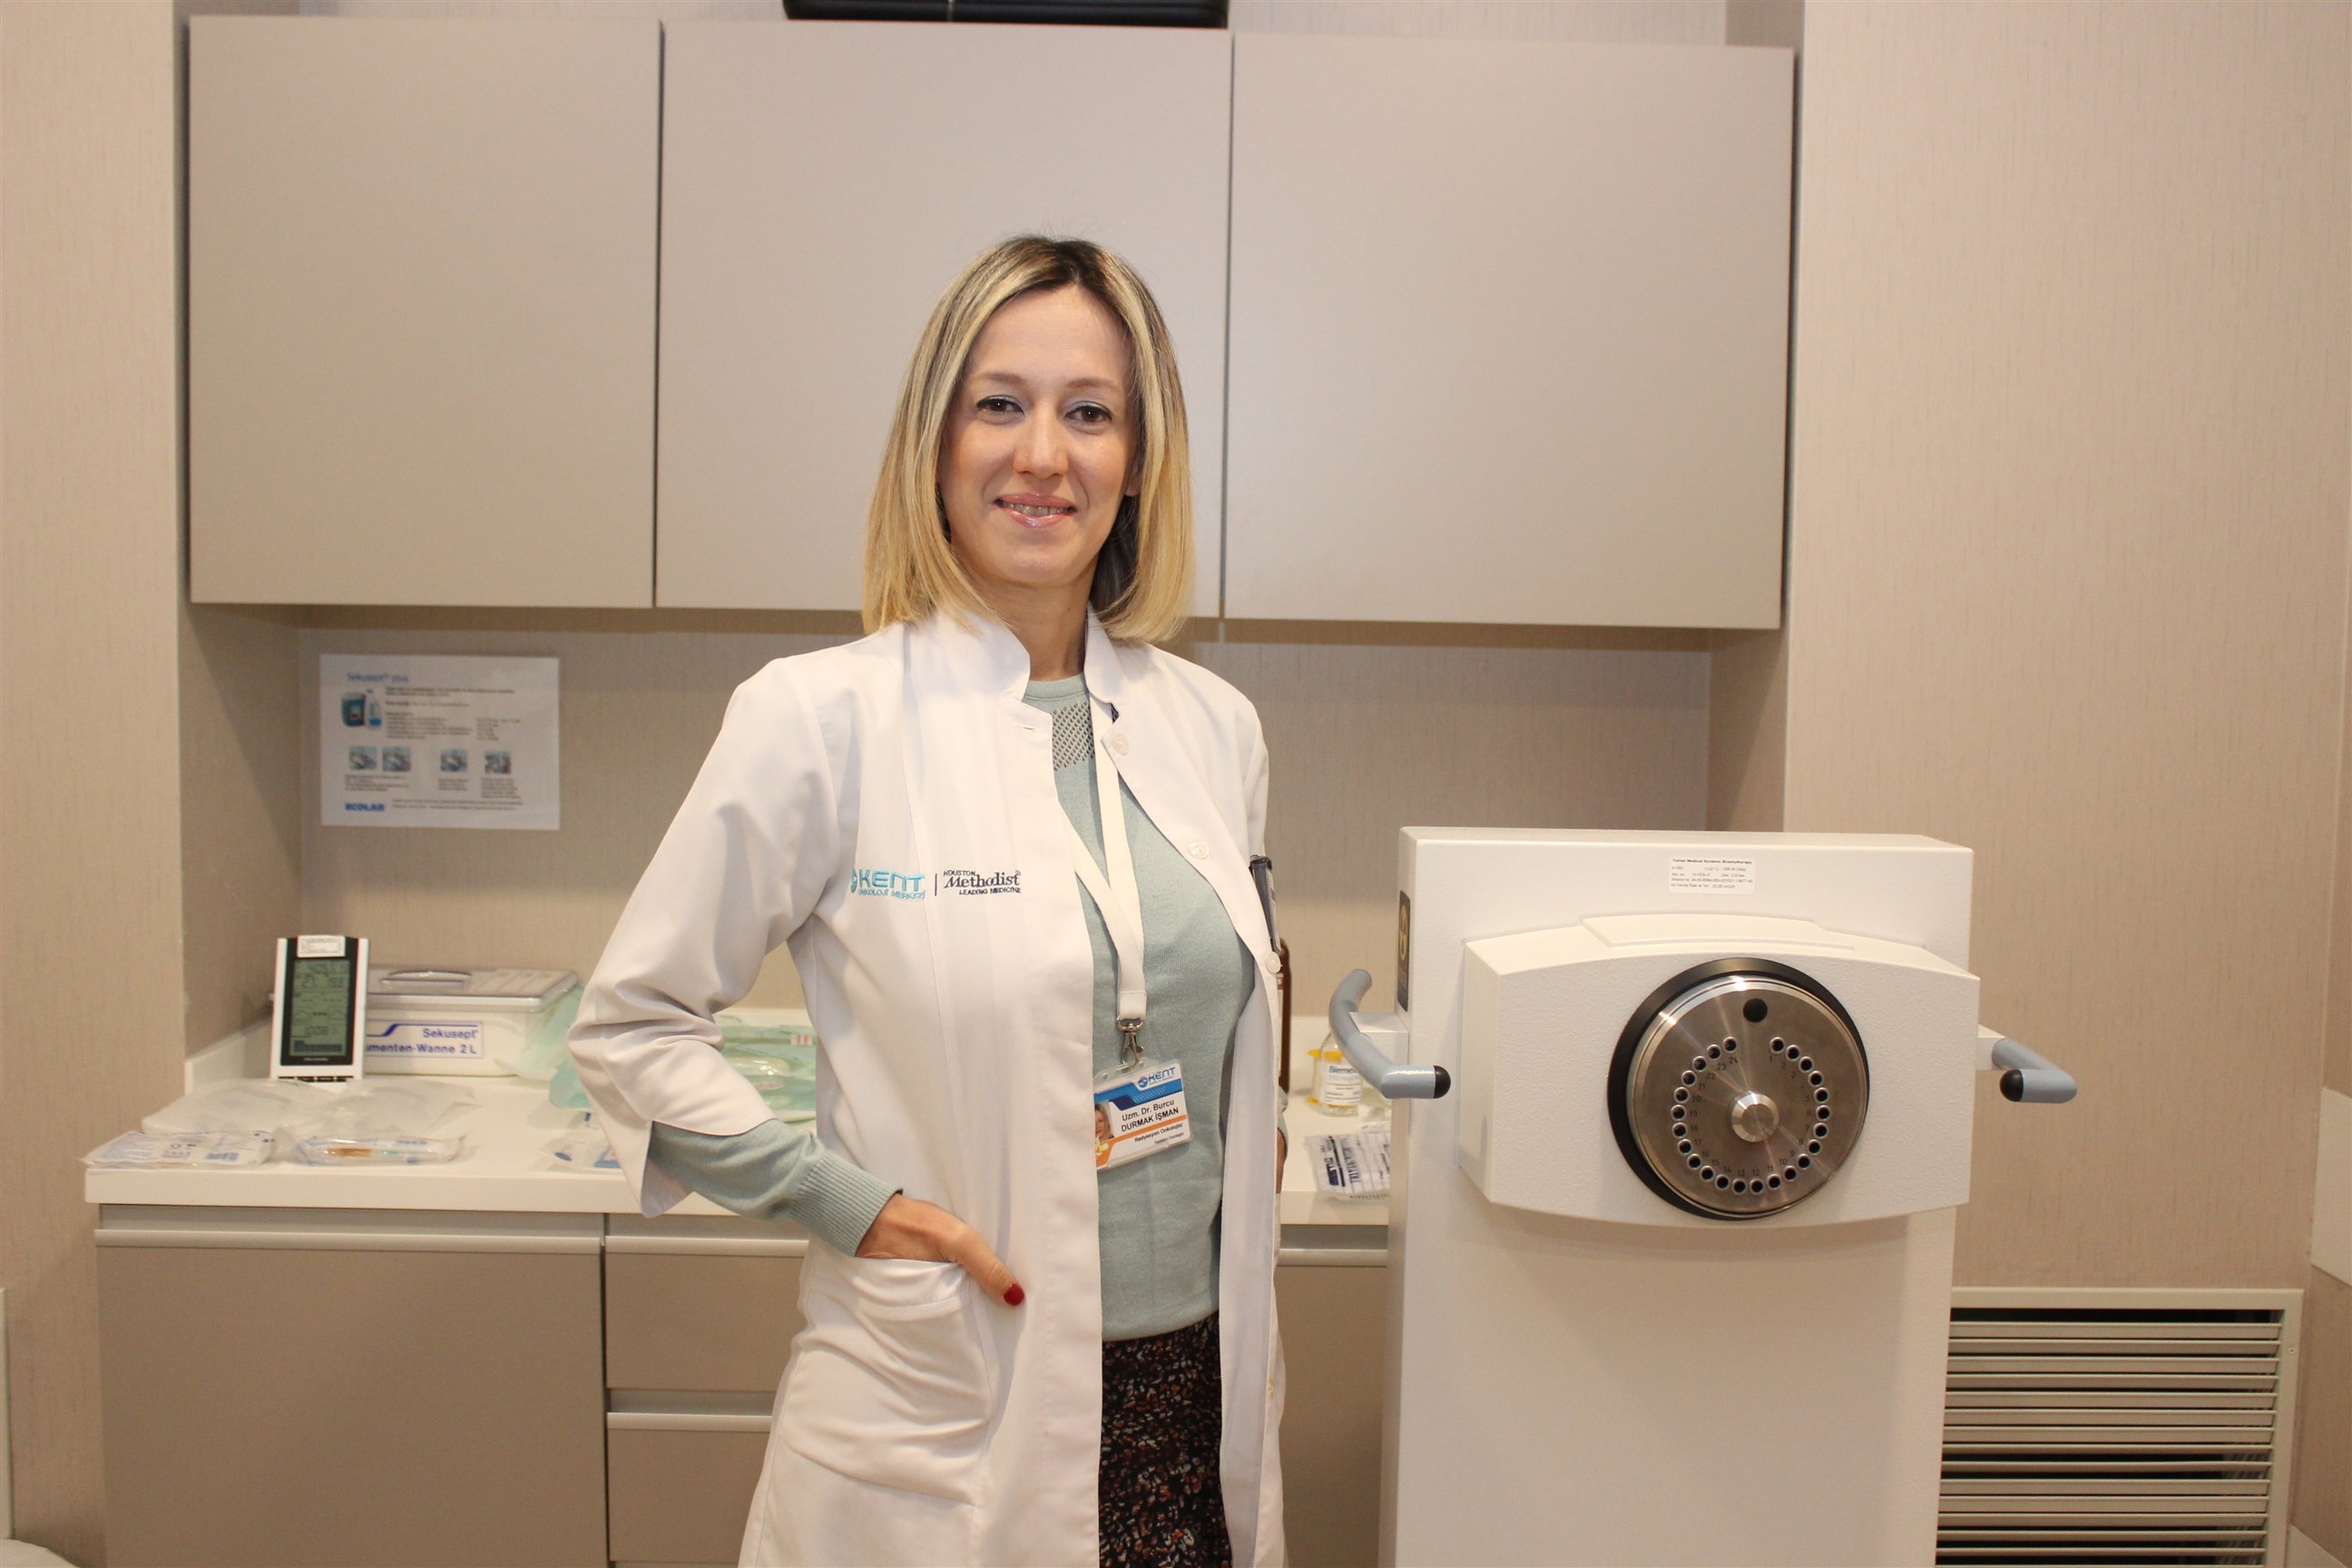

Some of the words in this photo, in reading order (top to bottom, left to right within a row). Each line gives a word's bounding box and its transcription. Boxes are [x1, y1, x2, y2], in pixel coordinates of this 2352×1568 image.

[858, 868, 925, 892] KENT
[944, 872, 1019, 888] Methodist
[366, 1044, 455, 1054] umenten-Wanne
[460, 1044, 467, 1054] 2
[469, 1044, 476, 1054] L
[1729, 1056, 1739, 1064] 24
[1148, 1066, 1175, 1082] KENT
[1122, 1112, 1140, 1122] Uzm.
[1141, 1107, 1152, 1115] Dr.
[1152, 1100, 1174, 1111] Burcu
[1121, 1115, 1154, 1132] DURMAK
[1155, 1107, 1179, 1121] İŞMAN
[1723, 1165, 1731, 1173] 14
